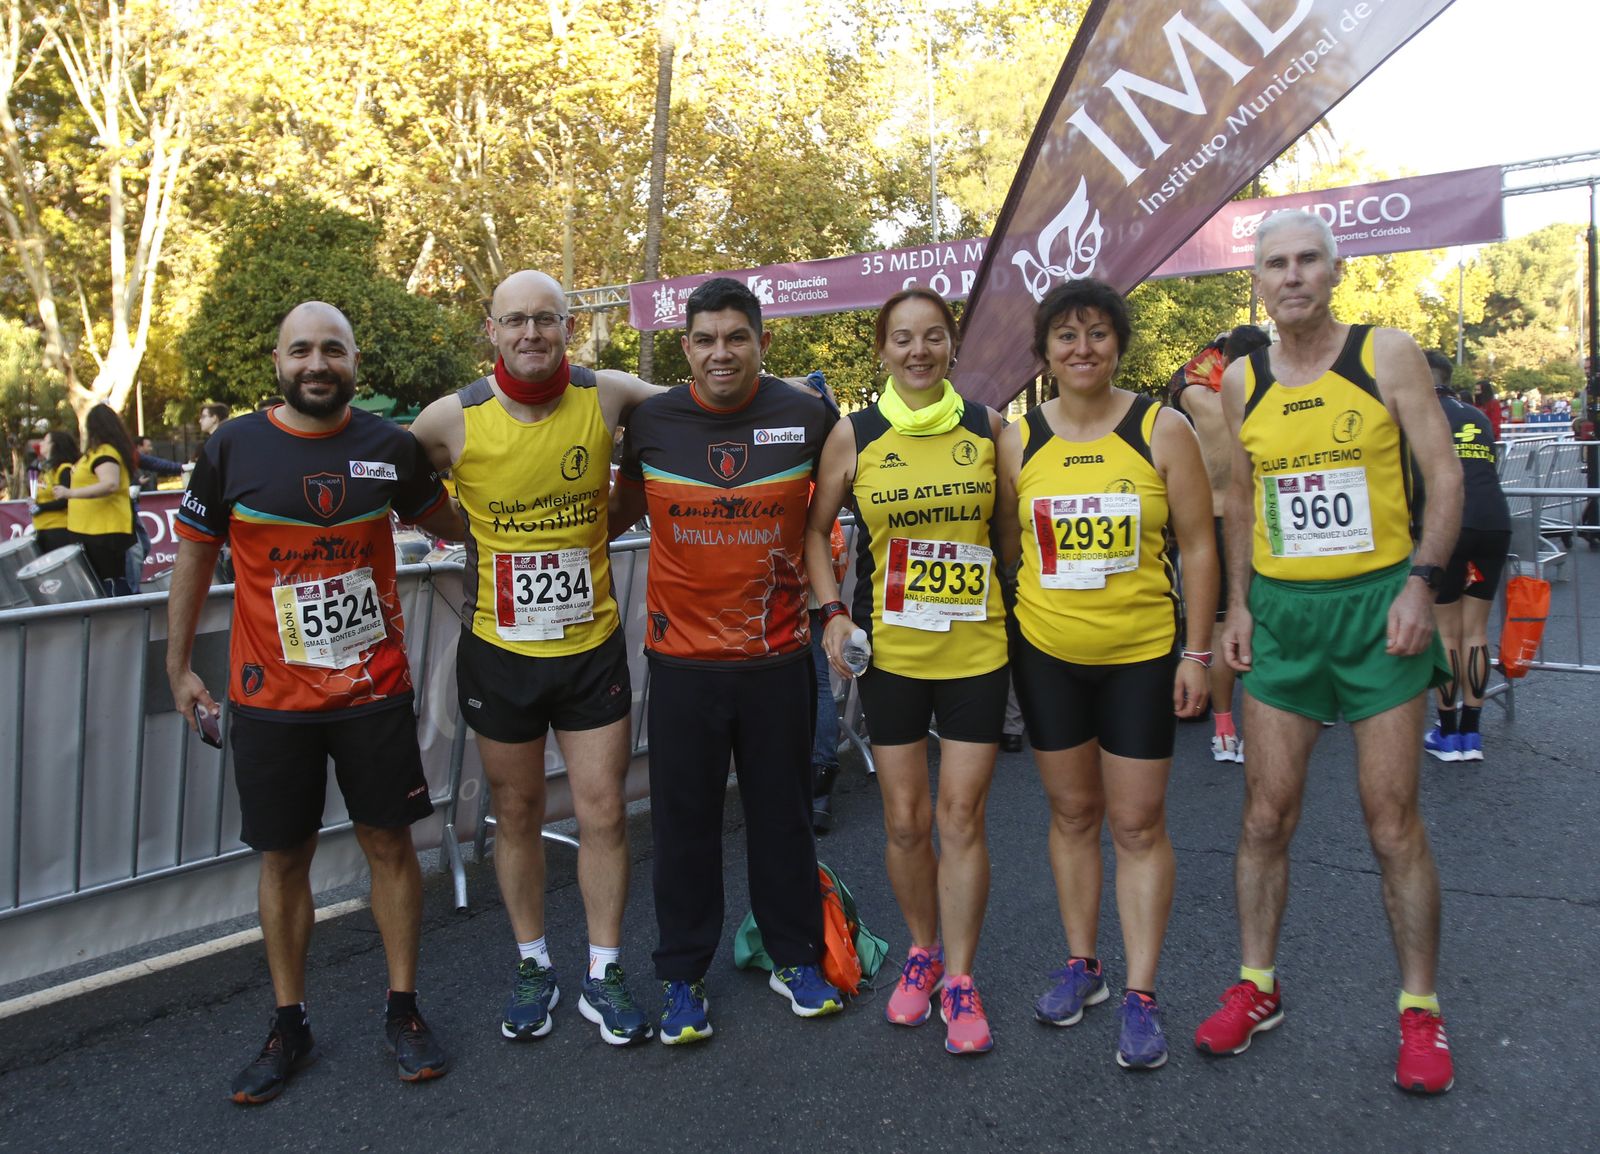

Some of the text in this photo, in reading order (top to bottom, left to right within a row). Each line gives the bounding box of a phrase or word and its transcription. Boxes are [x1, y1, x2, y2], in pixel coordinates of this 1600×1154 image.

[1137, 4, 1373, 216] Instituto Municipal de
[1333, 230, 1369, 242] eportes
[1371, 226, 1411, 238] Córdoba
[861, 255, 884, 276] 35
[889, 246, 958, 272] MEDIA
[777, 276, 828, 292] Diputación
[778, 289, 829, 303] de Córdoba
[1282, 397, 1325, 416] Joma
[770, 431, 803, 442] Inditer
[1063, 454, 1105, 467] Joma
[1262, 448, 1362, 472] CLUB ATLETISMO
[366, 466, 396, 478] Inditer
[488, 489, 600, 514] Club Atletismo
[871, 481, 992, 504] CLUB ATLETISMO
[493, 503, 598, 533] Montilla
[669, 495, 785, 519] amontillate
[888, 505, 982, 528] MONTILLA
[1291, 492, 1353, 530] 960
[673, 522, 725, 545] BATALLA
[737, 522, 781, 545] MUNDA
[1056, 515, 1132, 550] 2931
[1297, 530, 1340, 541] RODRIGUEZ
[1342, 527, 1369, 538] LOPEZ
[1073, 551, 1108, 560] CORDOBA
[516, 568, 590, 605] 3234
[908, 560, 985, 595] 2933
[302, 586, 378, 638] 5524
[529, 605, 547, 613] MARIA
[547, 603, 574, 612] CORDOBA
[574, 600, 591, 608] LUQUE
[920, 595, 959, 605] HERRADOR
[960, 597, 983, 606] LUQUE
[303, 639, 330, 648] ISMAEL
[329, 629, 357, 643] MONTES
[357, 619, 382, 635] JIMENEZ
